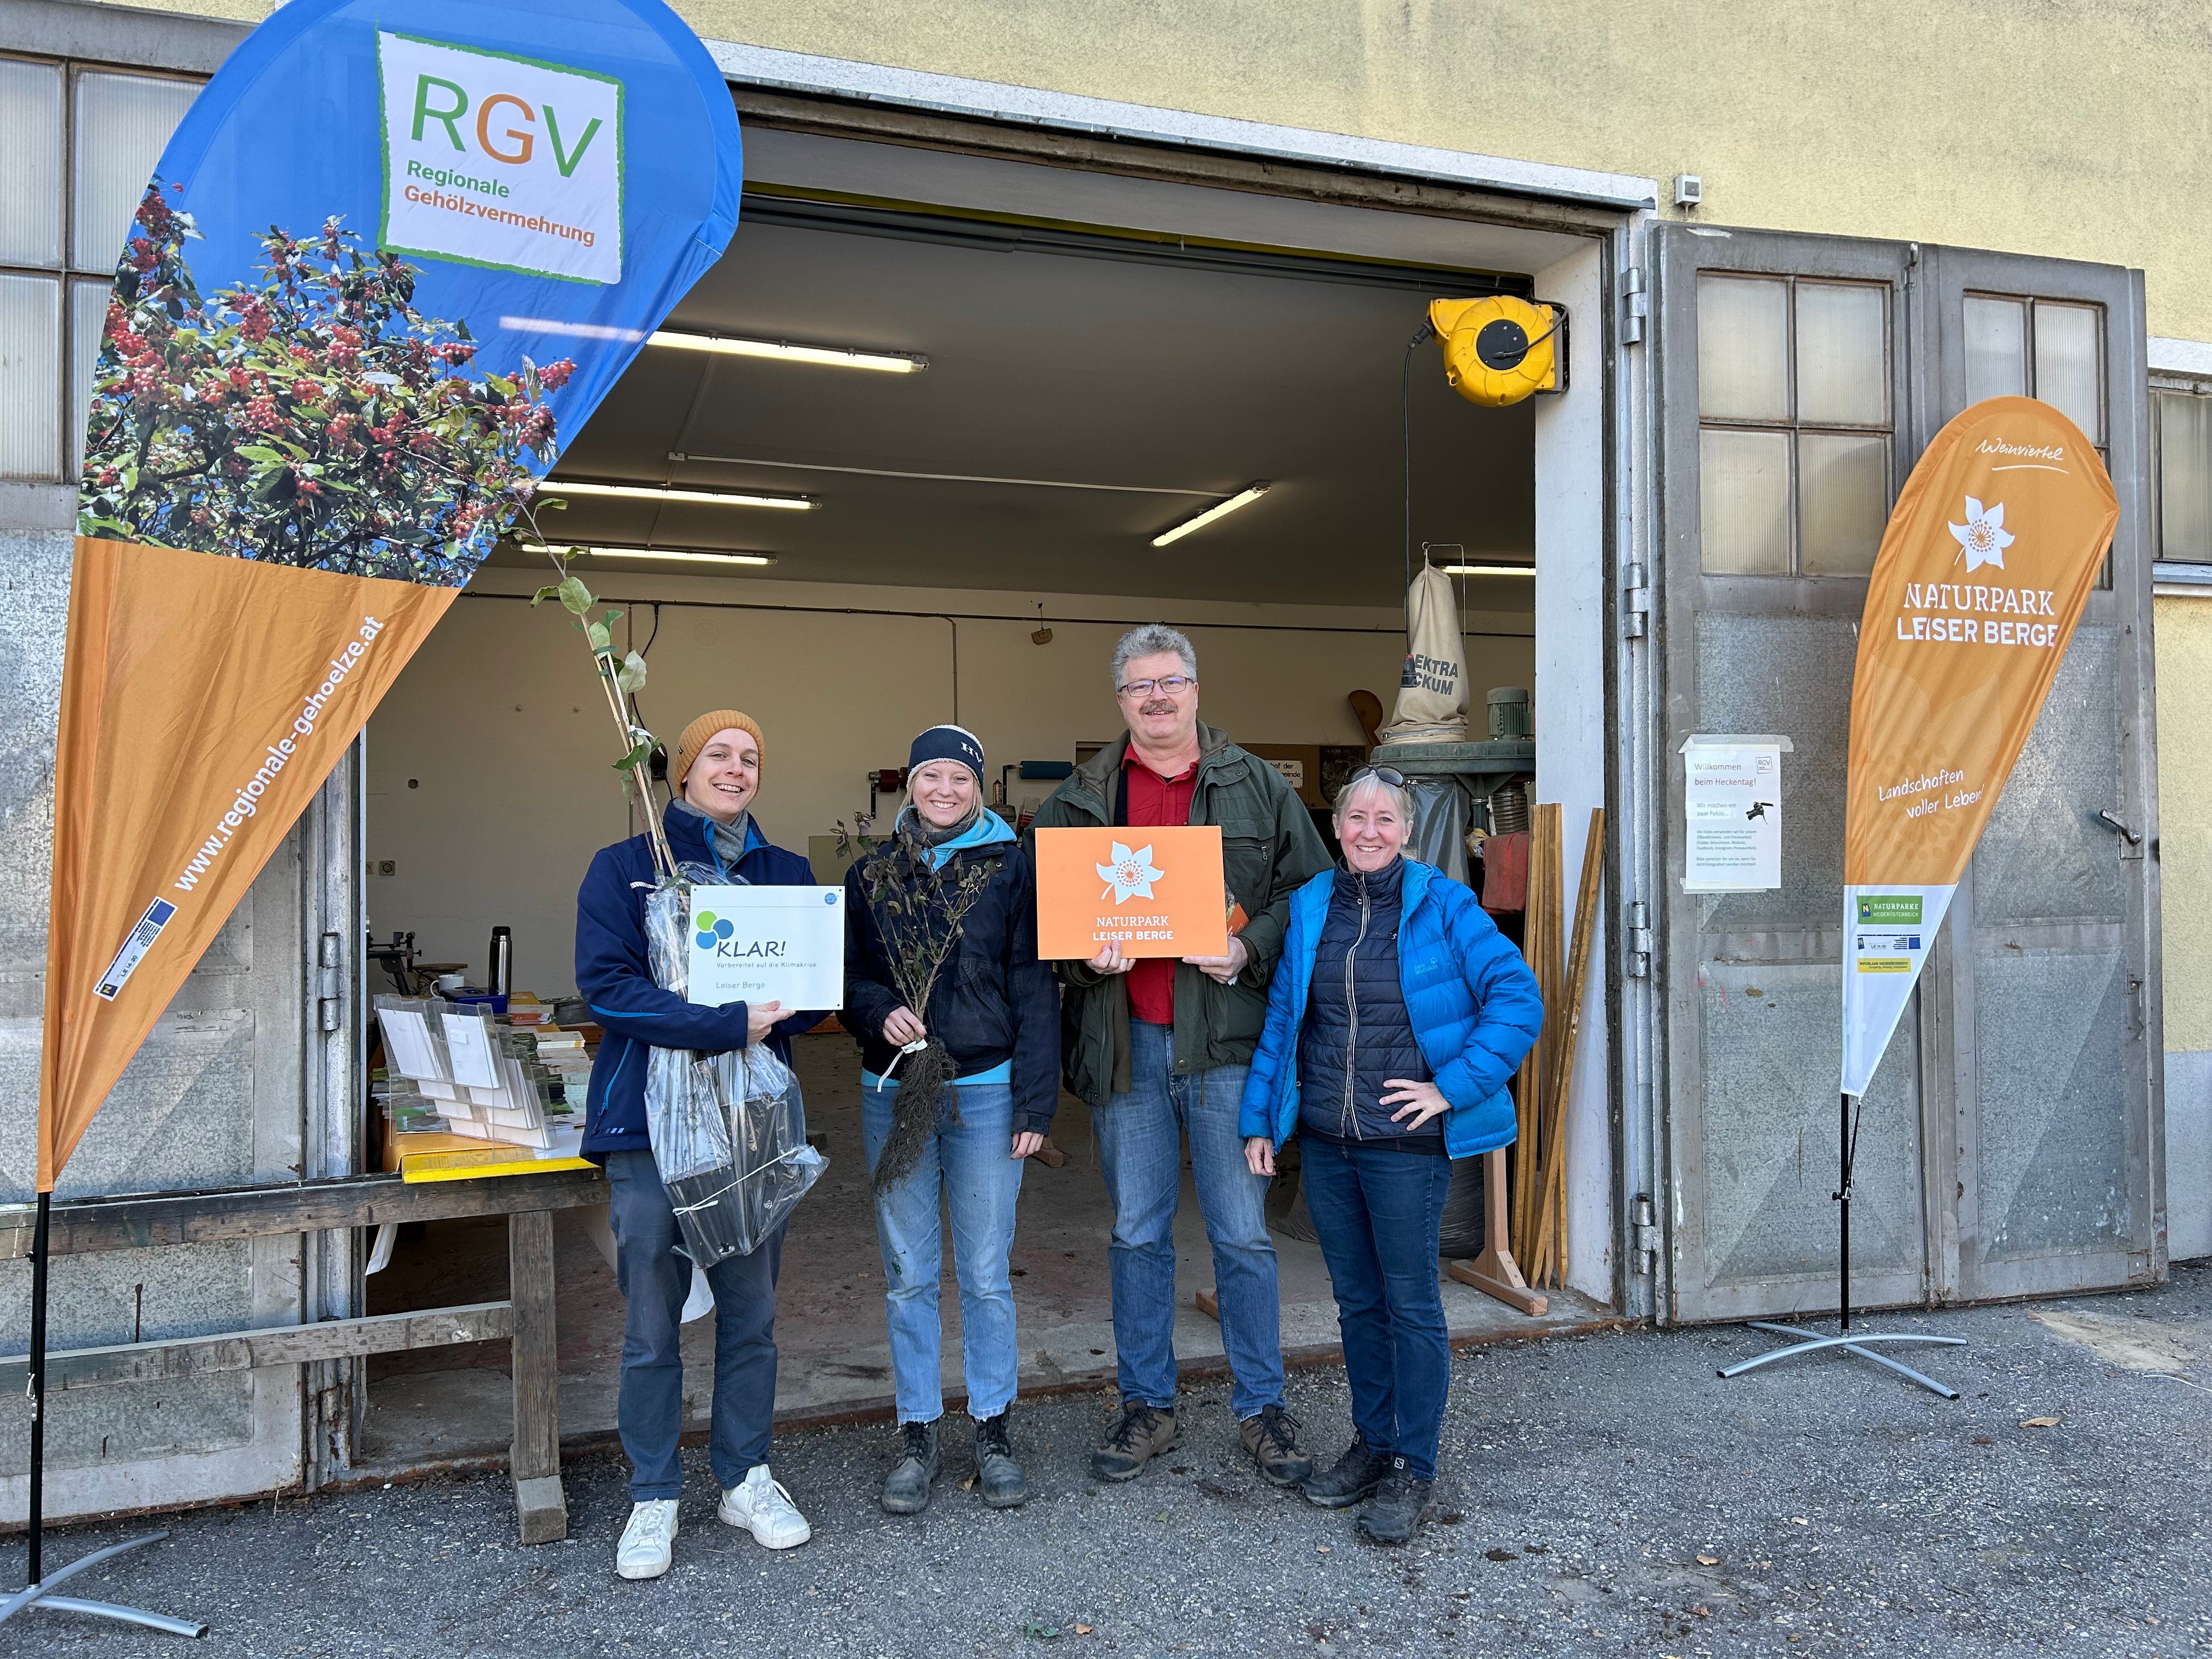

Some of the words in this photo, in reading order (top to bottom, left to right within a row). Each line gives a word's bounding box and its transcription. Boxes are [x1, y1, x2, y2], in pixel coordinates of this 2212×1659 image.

[411, 73, 603, 178] RGV
[407, 159, 510, 198] Regionale
[404, 185, 595, 247] Gehölzvermehrung
[1975, 438, 2063, 461] Weinviertel
[1903, 583, 2055, 616] NATURPARK
[1898, 617, 1978, 643] LEISER
[1984, 620, 2058, 647] BERGE
[1415, 653, 1458, 678] EKTRA
[1415, 672, 1454, 695] CKUM
[174, 615, 385, 892] www.regionale-gehoelze.at
[1716, 778, 1756, 787] Heckentag!
[1878, 769, 1963, 802] Landschaften
[1906, 799, 1939, 819] voller
[1096, 916, 1169, 927] NATURPARK
[1093, 932, 1133, 941] LEISER
[1136, 930, 1173, 940] BERGE
[716, 941, 786, 957] KLAR!
